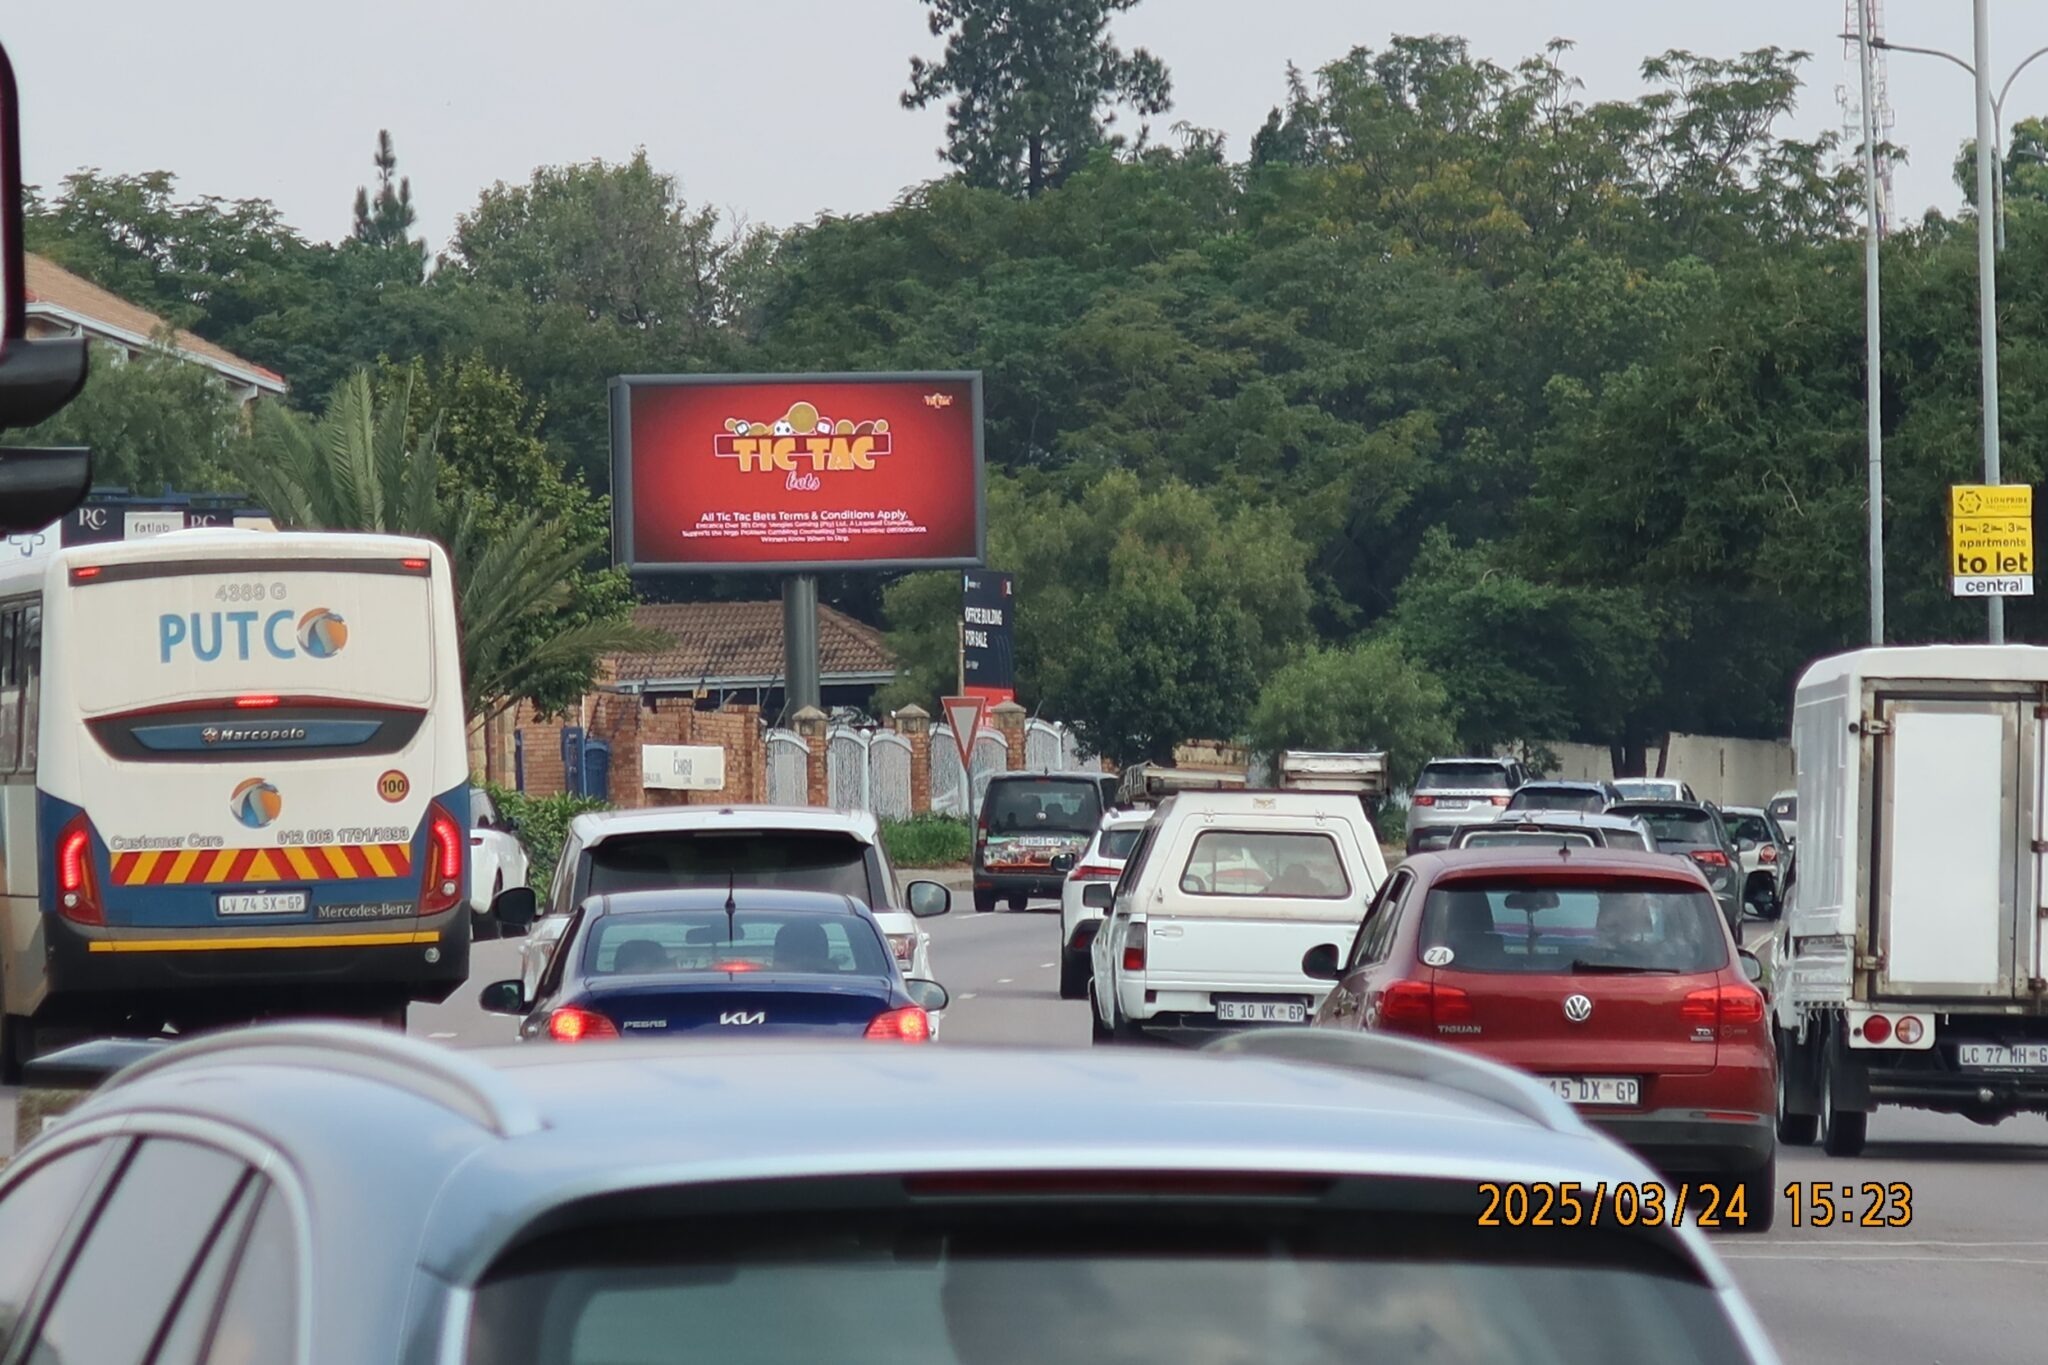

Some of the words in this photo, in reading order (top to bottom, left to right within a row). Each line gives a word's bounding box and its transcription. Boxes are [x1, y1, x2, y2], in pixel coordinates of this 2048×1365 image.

[733, 437, 798, 472] TIC
[806, 436, 876, 471] TAC
[78, 508, 107, 531] RC
[701, 512, 715, 523] All
[716, 512, 731, 521] Tic
[733, 511, 752, 521] Tac
[753, 511, 777, 521] Bets
[779, 510, 809, 521] Terms
[811, 510, 819, 521] &
[820, 509, 875, 521] Conditions
[877, 508, 909, 522] Apply.
[134, 516, 170, 533] fatlab
[1959, 524, 1964, 534] 1
[1982, 523, 1990, 534] 2
[2008, 522, 2016, 533] 3
[1959, 537, 2027, 550] apartments
[1958, 553, 1988, 574] to
[1996, 552, 2028, 573] let
[1965, 578, 2024, 593] central
[975, 630, 988, 648] SALE
[220, 727, 305, 742] Marcopolo
[382, 779, 405, 794] 100
[110, 834, 185, 850] Customer
[187, 832, 224, 848] Care
[277, 830, 304, 845] 012
[222, 898, 237, 912] LV
[242, 897, 257, 911] 74
[262, 896, 277, 911] SX
[287, 895, 302, 910] GP
[318, 903, 413, 919] Mercedes-Benz
[720, 1011, 765, 1025] KIA
[1219, 1003, 1234, 1019] HG
[1240, 1004, 1255, 1019] 10
[1262, 1005, 1276, 1019] VK
[1288, 1005, 1304, 1020] GP
[624, 1019, 667, 1030] PEGAS
[1438, 1025, 1482, 1034] TIGUAN
[1962, 1047, 1980, 1064] LC
[1986, 1047, 2003, 1063] 77
[1579, 1080, 1600, 1101] DX
[1616, 1081, 1636, 1102] GP
